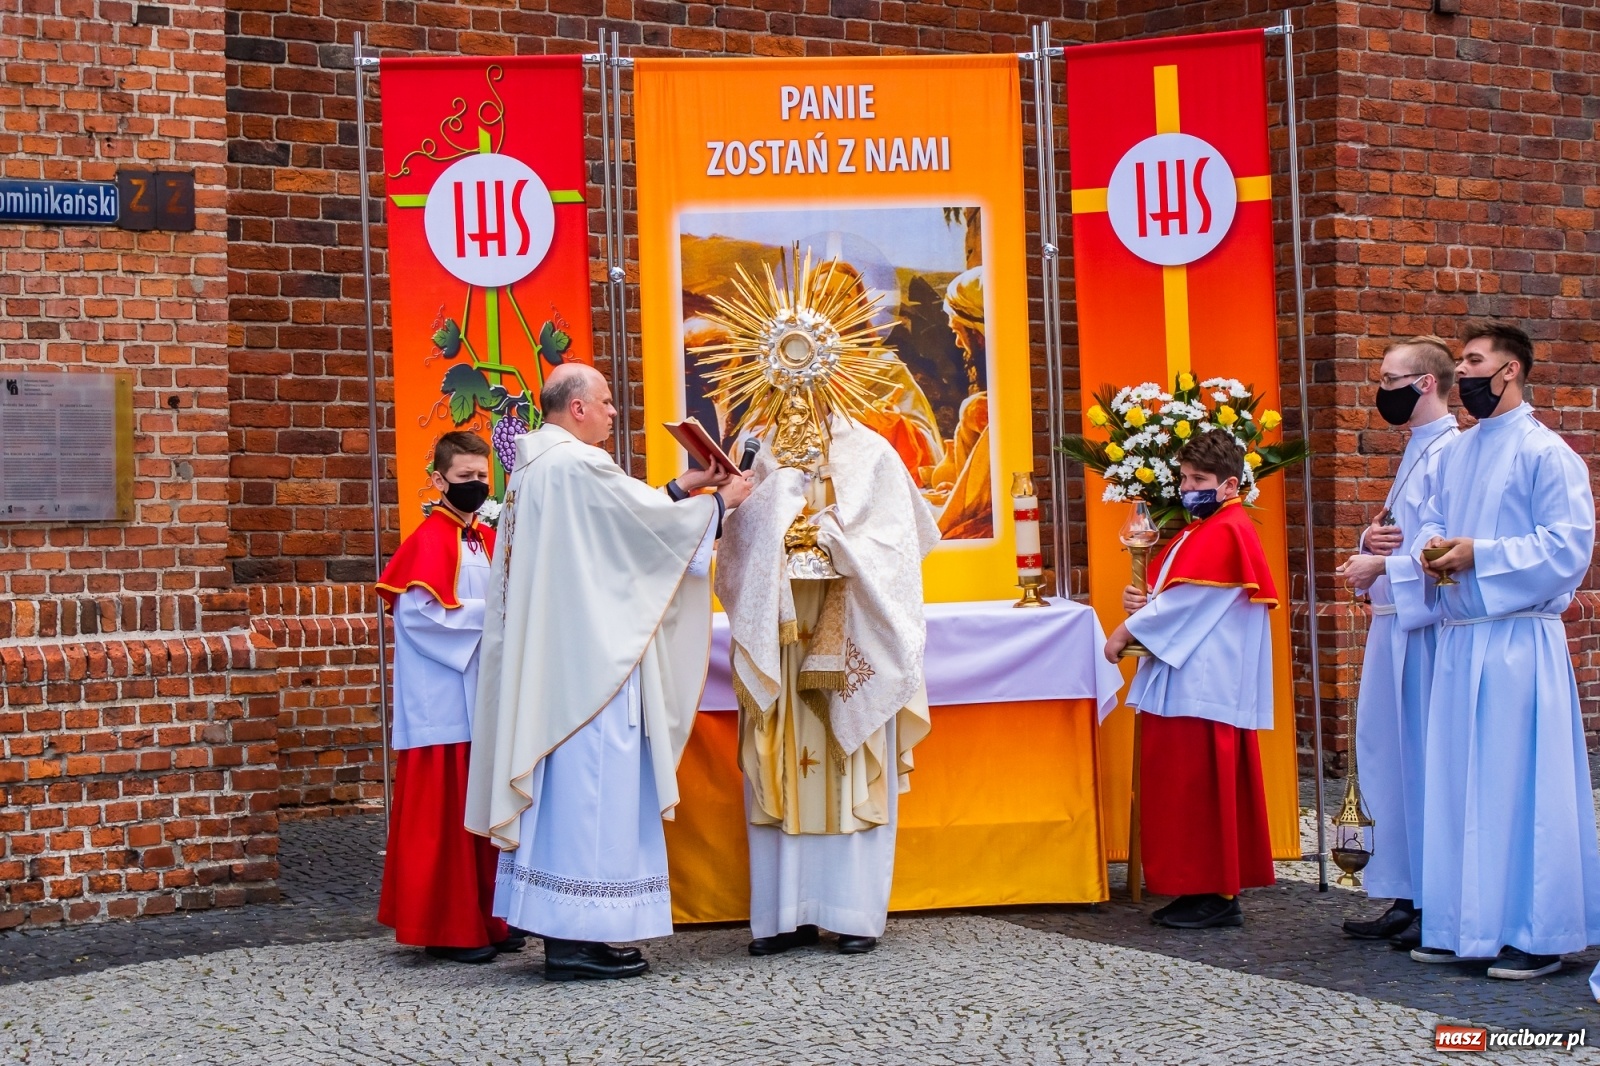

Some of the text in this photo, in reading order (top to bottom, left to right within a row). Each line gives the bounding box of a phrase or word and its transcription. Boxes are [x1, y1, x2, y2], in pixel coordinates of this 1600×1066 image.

[780, 84, 875, 120] PANIE
[706, 131, 950, 176] ZOSTAŃ Z NAMI
[453, 179, 531, 258] IHS
[1135, 157, 1212, 238] IHS
